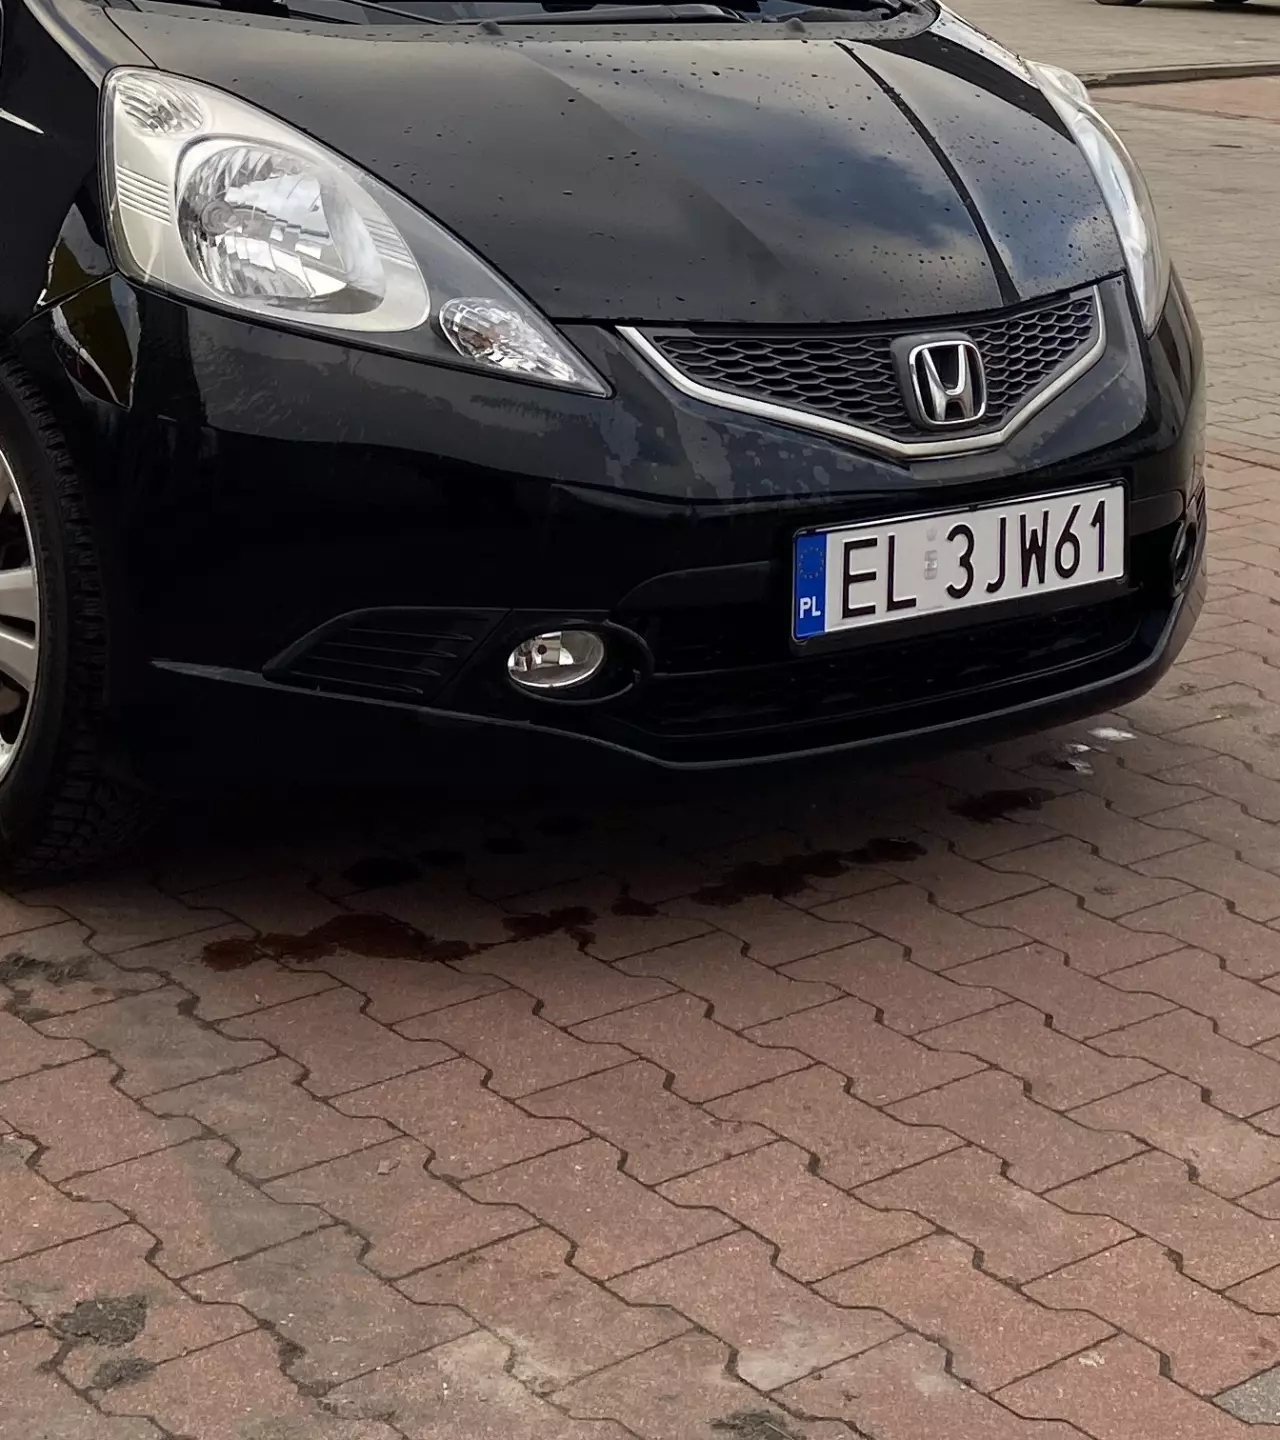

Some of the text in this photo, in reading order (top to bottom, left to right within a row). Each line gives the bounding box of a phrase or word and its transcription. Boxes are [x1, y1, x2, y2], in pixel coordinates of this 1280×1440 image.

[841, 500, 1107, 619] EL 3JW61
[799, 596, 822, 619] PL
